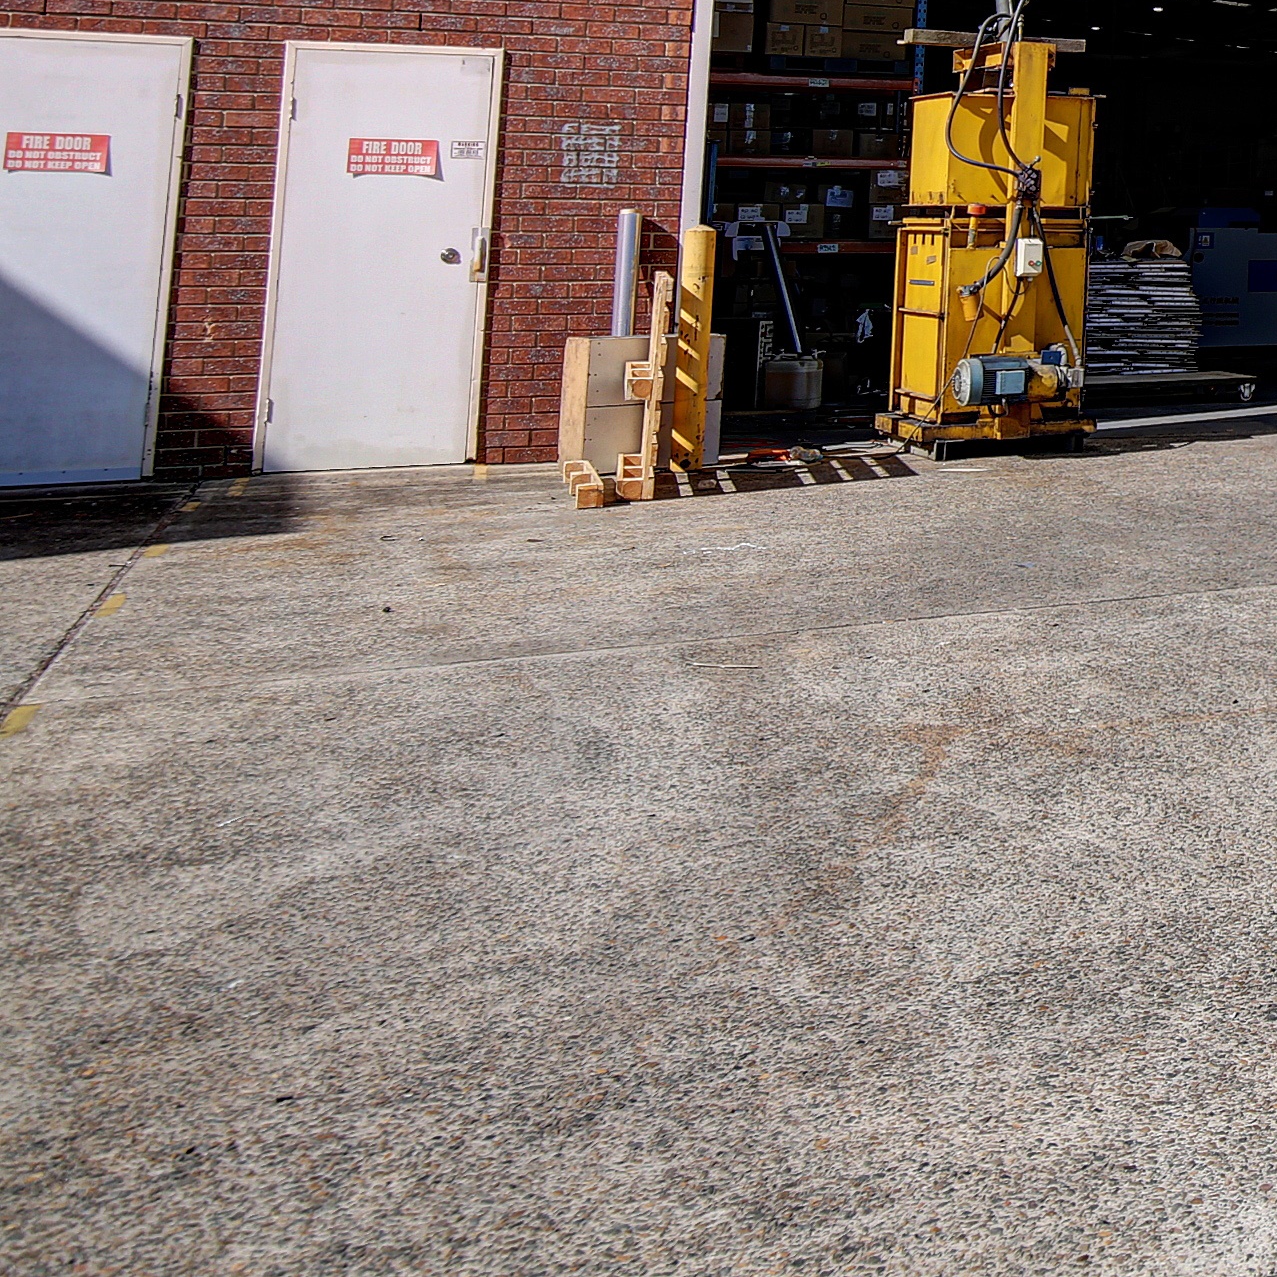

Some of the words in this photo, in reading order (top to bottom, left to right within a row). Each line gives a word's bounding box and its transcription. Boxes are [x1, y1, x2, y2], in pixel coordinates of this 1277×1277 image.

[22, 135, 50, 149] FIRE
[55, 136, 92, 150] DOOR
[362, 141, 387, 153] FIRE
[391, 142, 422, 154] DOOR
[8, 150, 23, 158] DO
[24, 150, 46, 159] NOT
[47, 151, 102, 160] OBSTRUCT
[350, 155, 363, 163] DO
[365, 155, 383, 163] NOT
[384, 155, 432, 164] OBSTRUCT
[7, 159, 23, 168] DO
[24, 160, 46, 168] NOT
[46, 160, 72, 169] KEEP
[74, 161, 101, 170] OPEN
[365, 164, 383, 172] NOT
[384, 164, 407, 172] KEEP
[408, 165, 431, 173] OPEN
